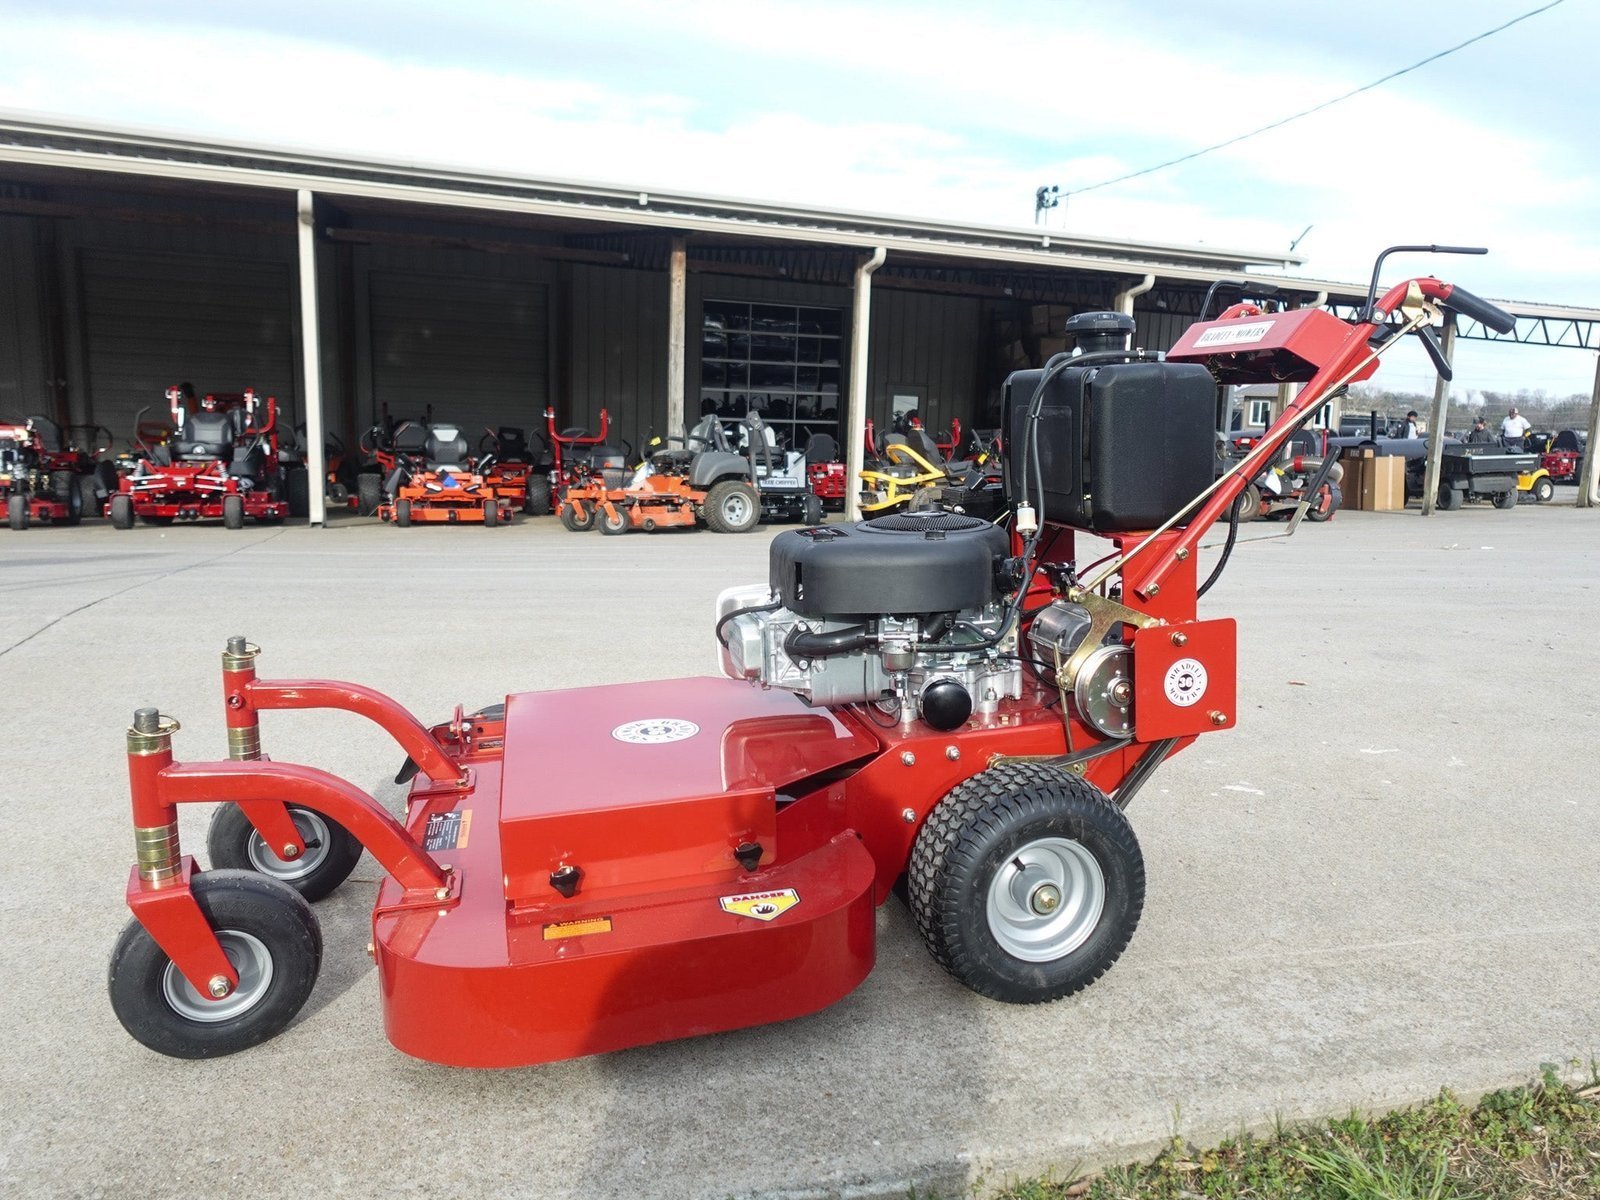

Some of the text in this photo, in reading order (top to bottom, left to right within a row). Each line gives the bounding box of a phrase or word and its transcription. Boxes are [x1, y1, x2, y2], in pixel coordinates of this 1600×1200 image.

[1170, 663, 1203, 680] BRADLEY
[1178, 676, 1193, 688] 36
[1170, 687, 1201, 702] MOWERS
[732, 891, 785, 903] DANGER
[559, 917, 604, 927] WARNING
